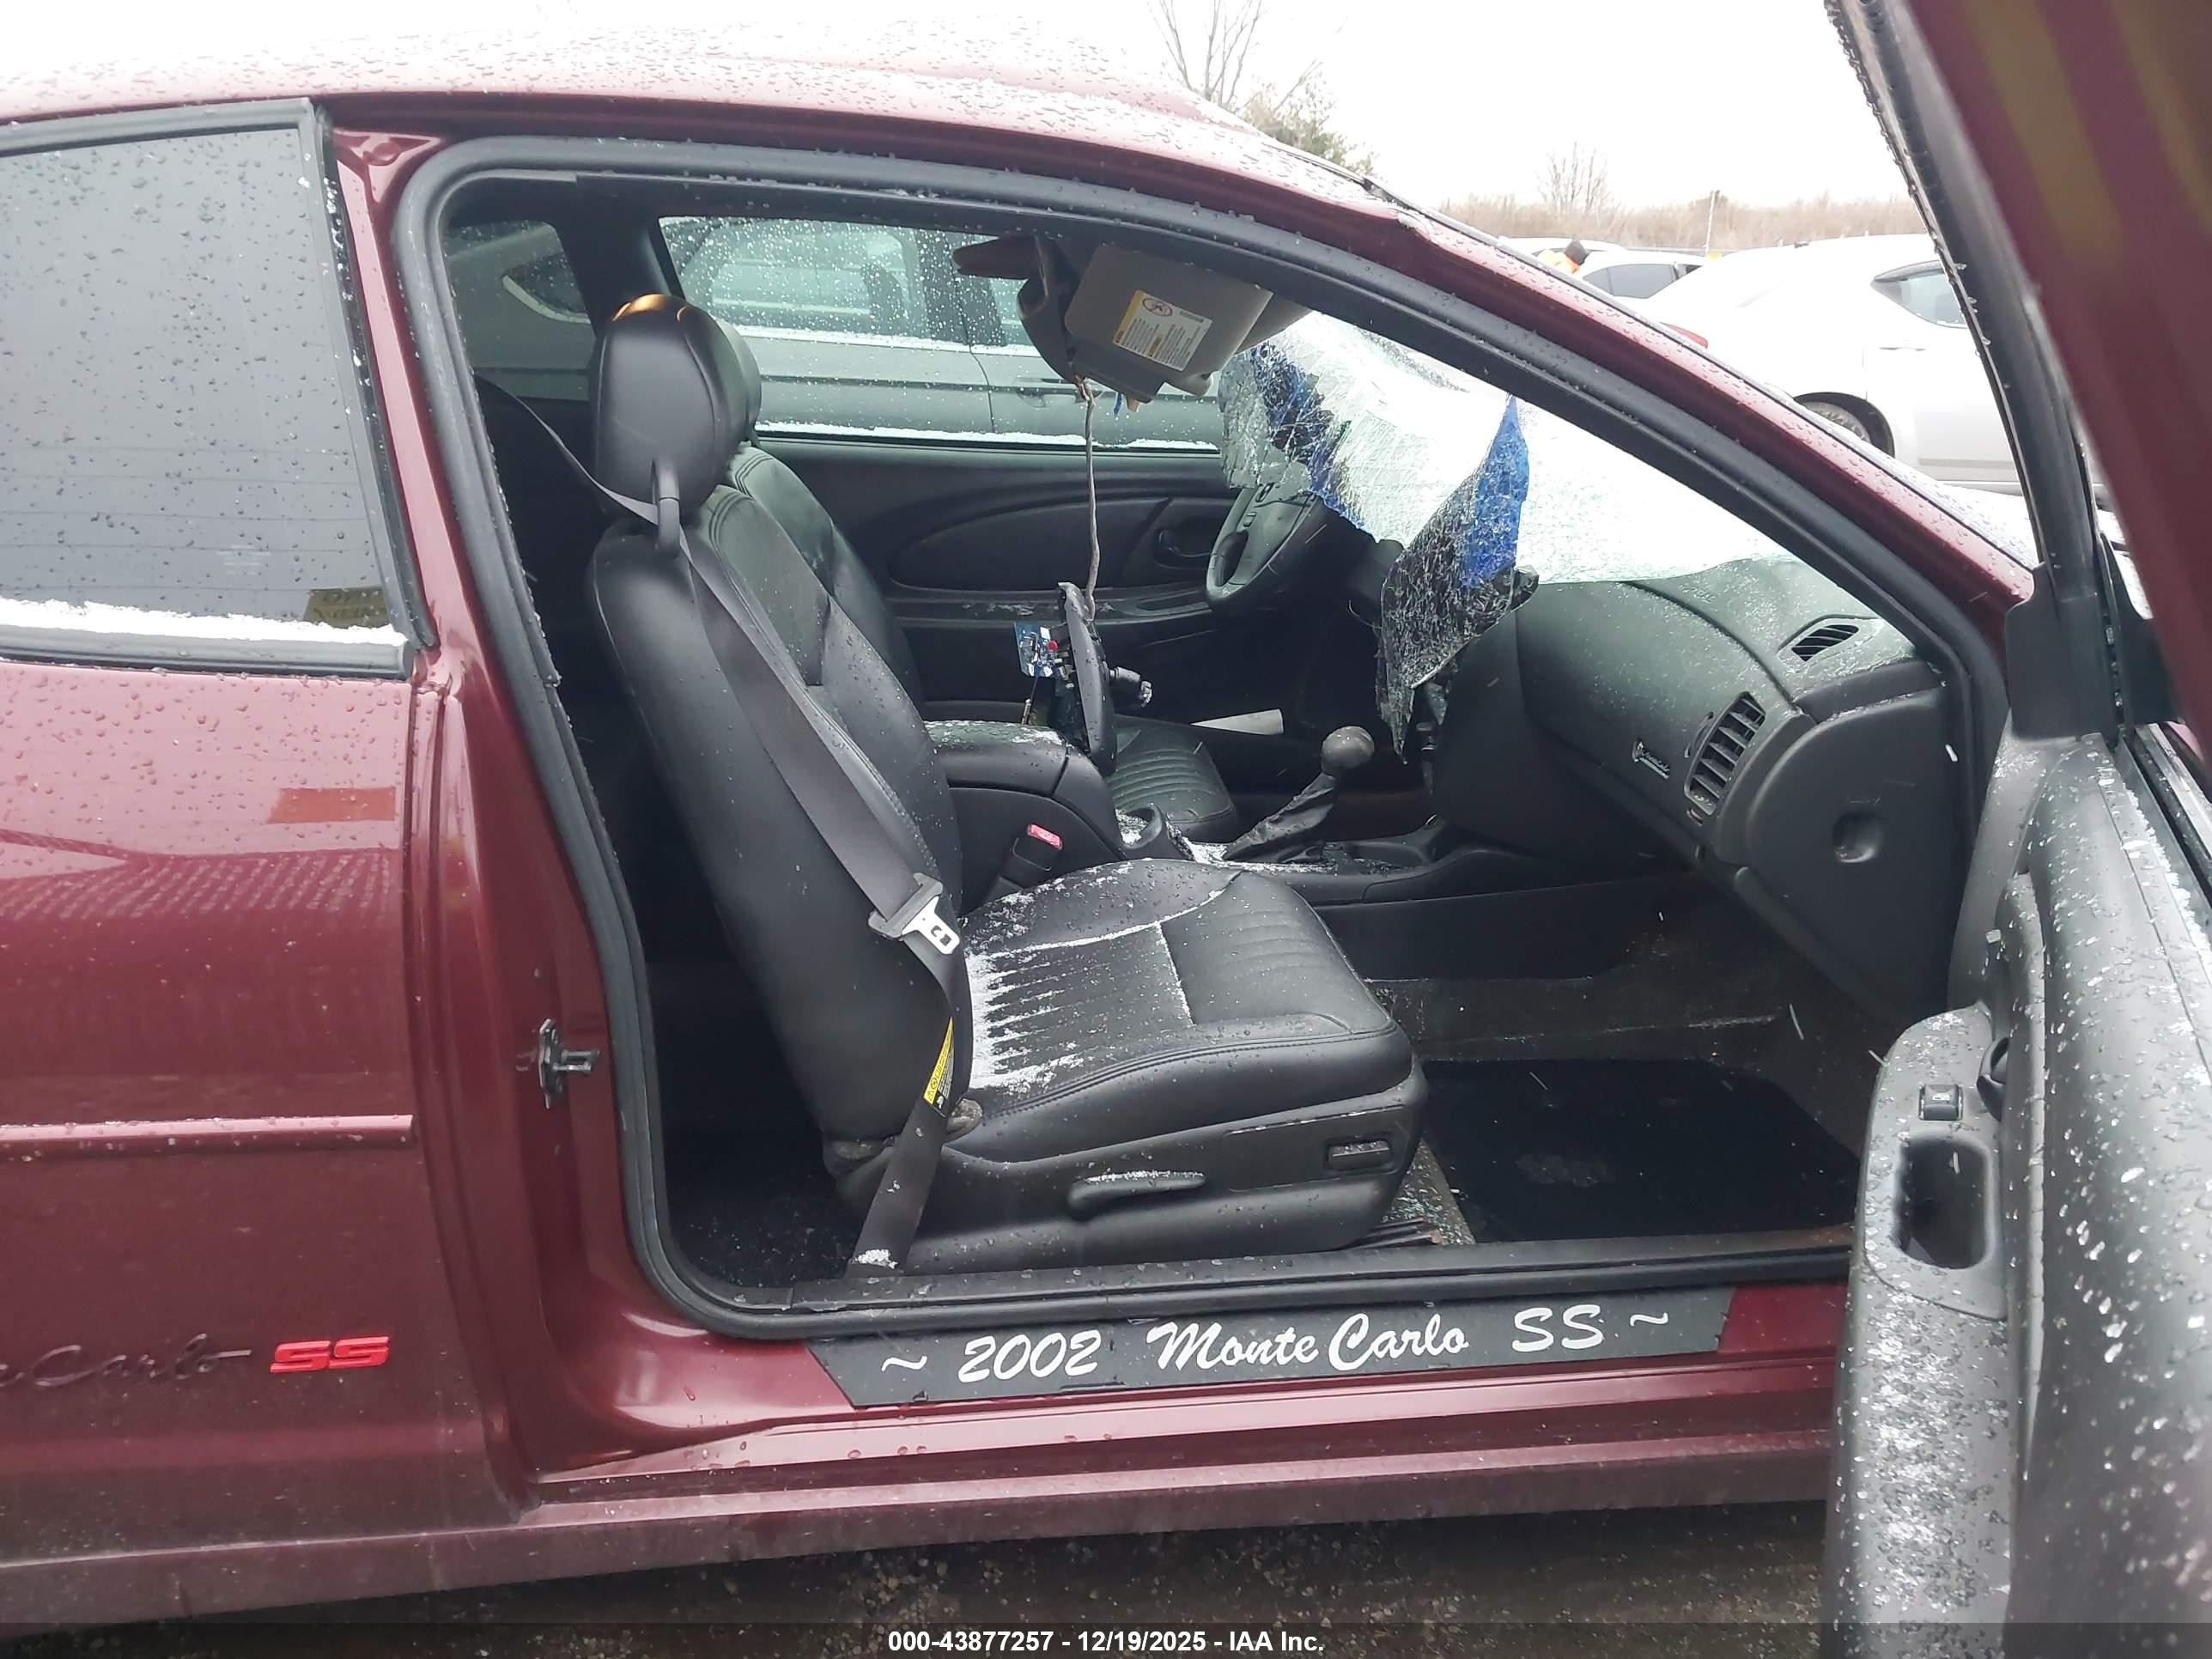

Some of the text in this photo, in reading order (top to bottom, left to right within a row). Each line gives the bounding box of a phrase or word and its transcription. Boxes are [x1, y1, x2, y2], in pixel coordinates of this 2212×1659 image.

[269, 1334, 390, 1374] SS
[957, 1328, 1103, 1384] 2002
[1145, 1322, 1320, 1372] Monte
[1327, 1313, 1471, 1372] Carlo
[1510, 1304, 1606, 1353] SS
